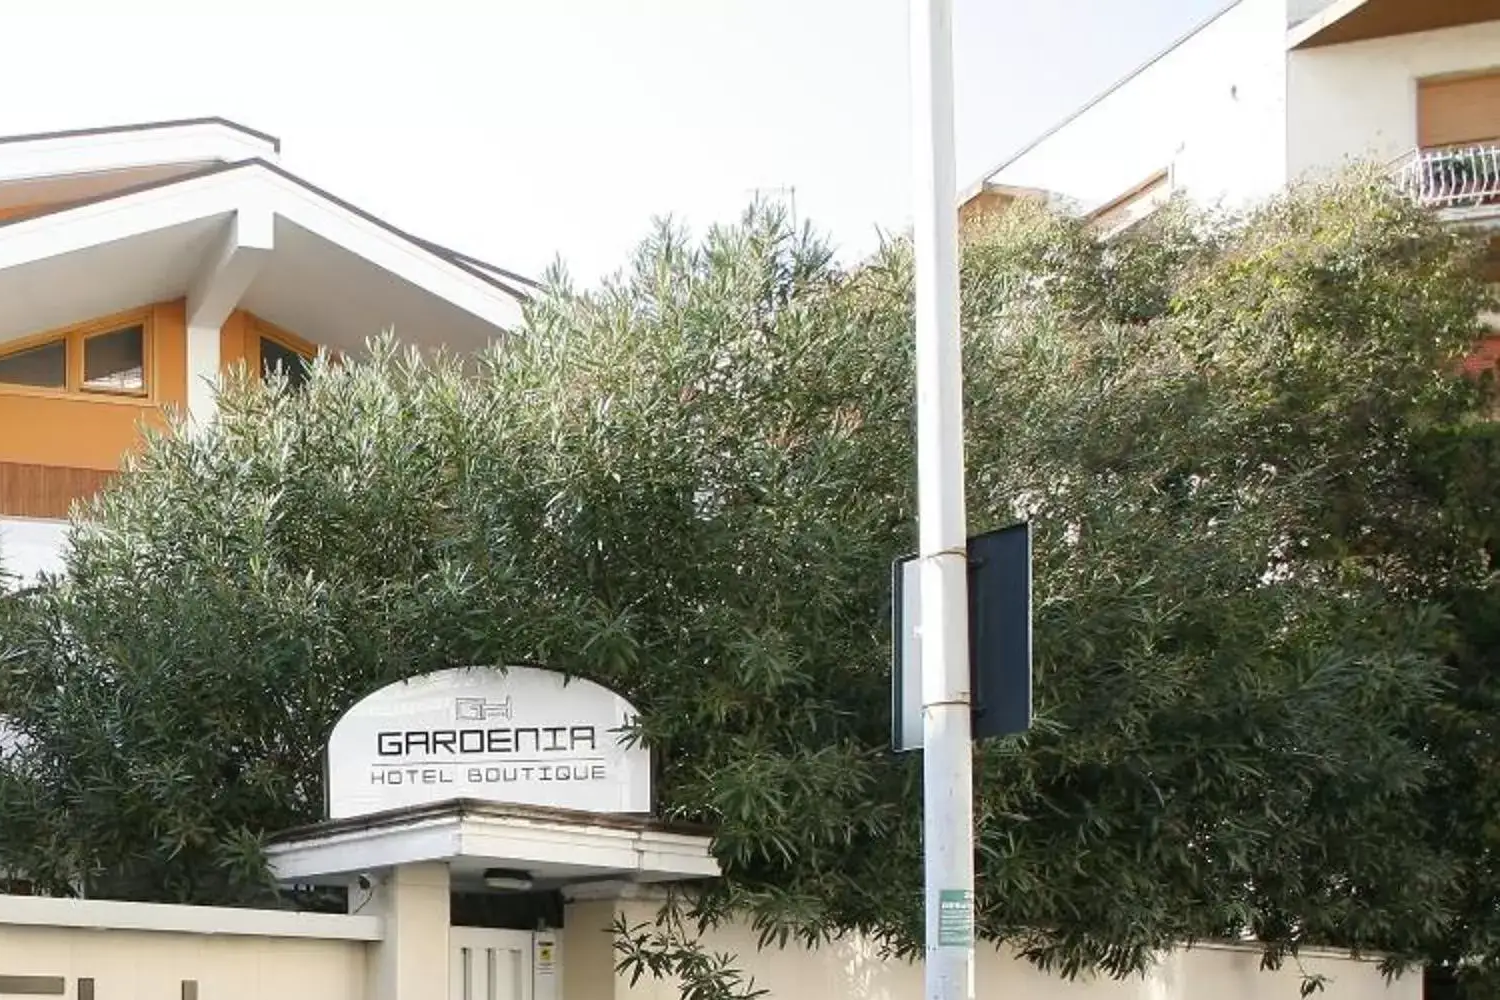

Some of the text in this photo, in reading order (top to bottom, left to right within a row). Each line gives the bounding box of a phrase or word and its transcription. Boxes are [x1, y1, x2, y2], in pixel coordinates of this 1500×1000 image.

[377, 726, 596, 757] GARDENIA
[371, 765, 606, 785] HOTEL BOUTIQUE
